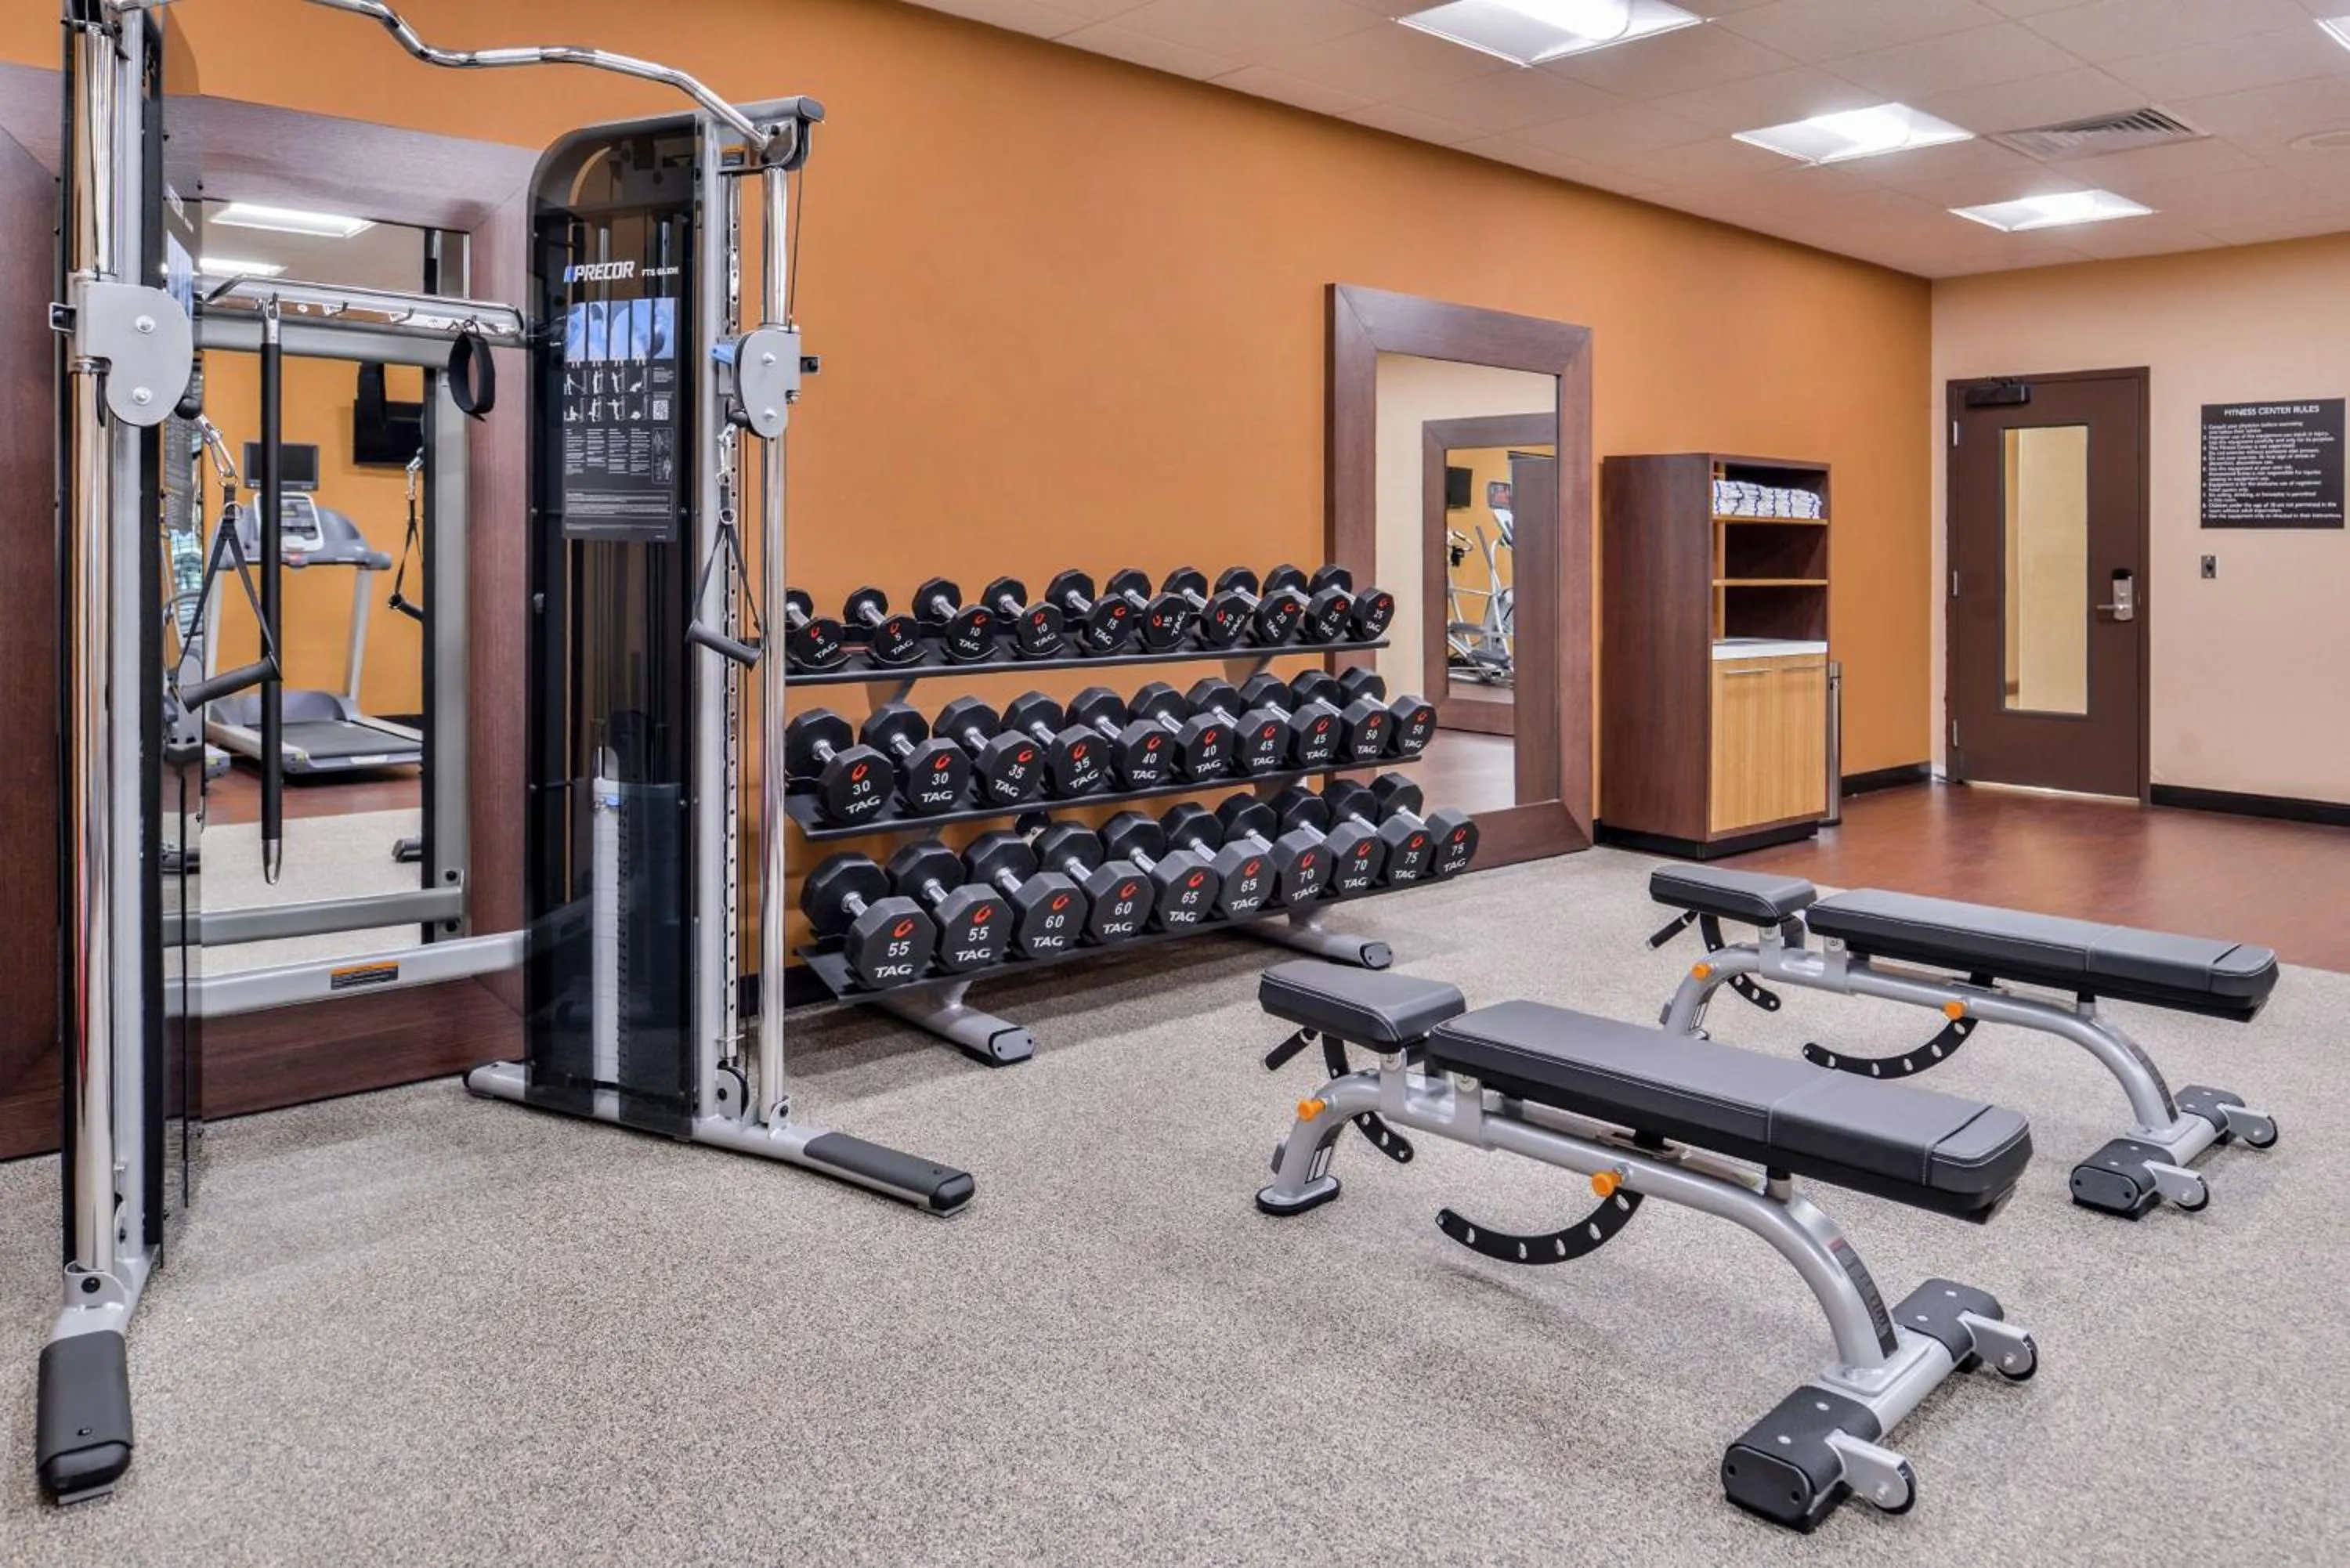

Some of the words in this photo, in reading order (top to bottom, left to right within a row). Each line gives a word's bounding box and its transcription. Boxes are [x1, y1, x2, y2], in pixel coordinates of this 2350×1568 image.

[573, 261, 634, 282] PRECOR
[2224, 407, 2256, 417] FITNESS
[2258, 406, 2291, 415] CENTER
[2293, 405, 2319, 414] RULES
[1319, 623, 1333, 636] TAG
[1365, 622, 1380, 633] TAG
[1033, 633, 1057, 648] TAG
[1094, 628, 1113, 646] TAG
[815, 642, 838, 659] TAG
[890, 640, 914, 656] TAG
[959, 638, 979, 651] TAG
[1365, 729, 1378, 740] 50
[1412, 724, 1423, 735] 50
[1314, 733, 1326, 745] 45
[1404, 739, 1423, 748] TAG
[1202, 745, 1217, 757] 40
[1260, 740, 1274, 752] 45
[1357, 746, 1376, 754] TAG
[1142, 752, 1157, 764] 40
[1253, 756, 1275, 766] TAG
[1306, 749, 1329, 760] TAG
[1073, 757, 1091, 772] 35
[1196, 760, 1221, 774] TAG
[1008, 764, 1025, 779] 35
[1132, 770, 1157, 779] TAG
[931, 772, 949, 786] 30
[1069, 770, 1099, 789] TAG
[851, 781, 870, 794] 30
[995, 779, 1019, 798] TAG
[921, 790, 953, 803] TAG
[846, 797, 880, 815] TAG
[1405, 851, 1417, 863] 75
[1452, 845, 1464, 856] 75
[1354, 859, 1367, 872] 70
[1443, 858, 1466, 873] TAG
[1300, 869, 1315, 881] 70
[1394, 869, 1416, 880] TAG
[1240, 879, 1256, 892] 65
[1343, 876, 1368, 888] TAG
[1181, 891, 1198, 903] 65
[1292, 883, 1320, 902] TAG
[1115, 902, 1132, 916] 60
[1231, 897, 1260, 912] TAG
[1045, 915, 1064, 928] 60
[1169, 911, 1197, 923] TAG
[968, 927, 989, 941] 55
[1102, 922, 1133, 934] TAG
[1032, 936, 1064, 948] TAG
[888, 941, 909, 957] 55
[956, 948, 991, 962] TAG
[874, 964, 913, 978] TAG
